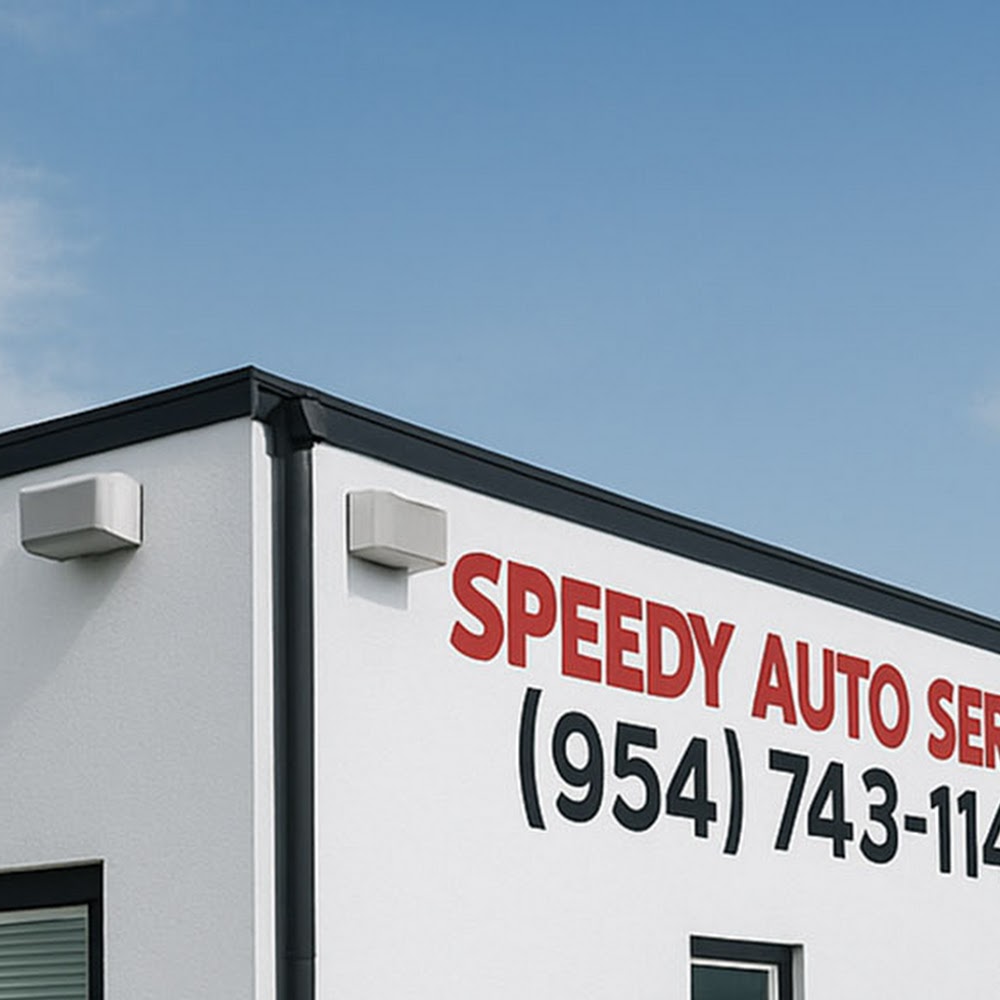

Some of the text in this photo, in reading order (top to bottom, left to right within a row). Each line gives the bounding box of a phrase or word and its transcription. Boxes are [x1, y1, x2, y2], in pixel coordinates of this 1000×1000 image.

[450, 552, 736, 709] SPEEDY
[751, 632, 911, 750] AUTO
[518, 687, 744, 856] (954)
